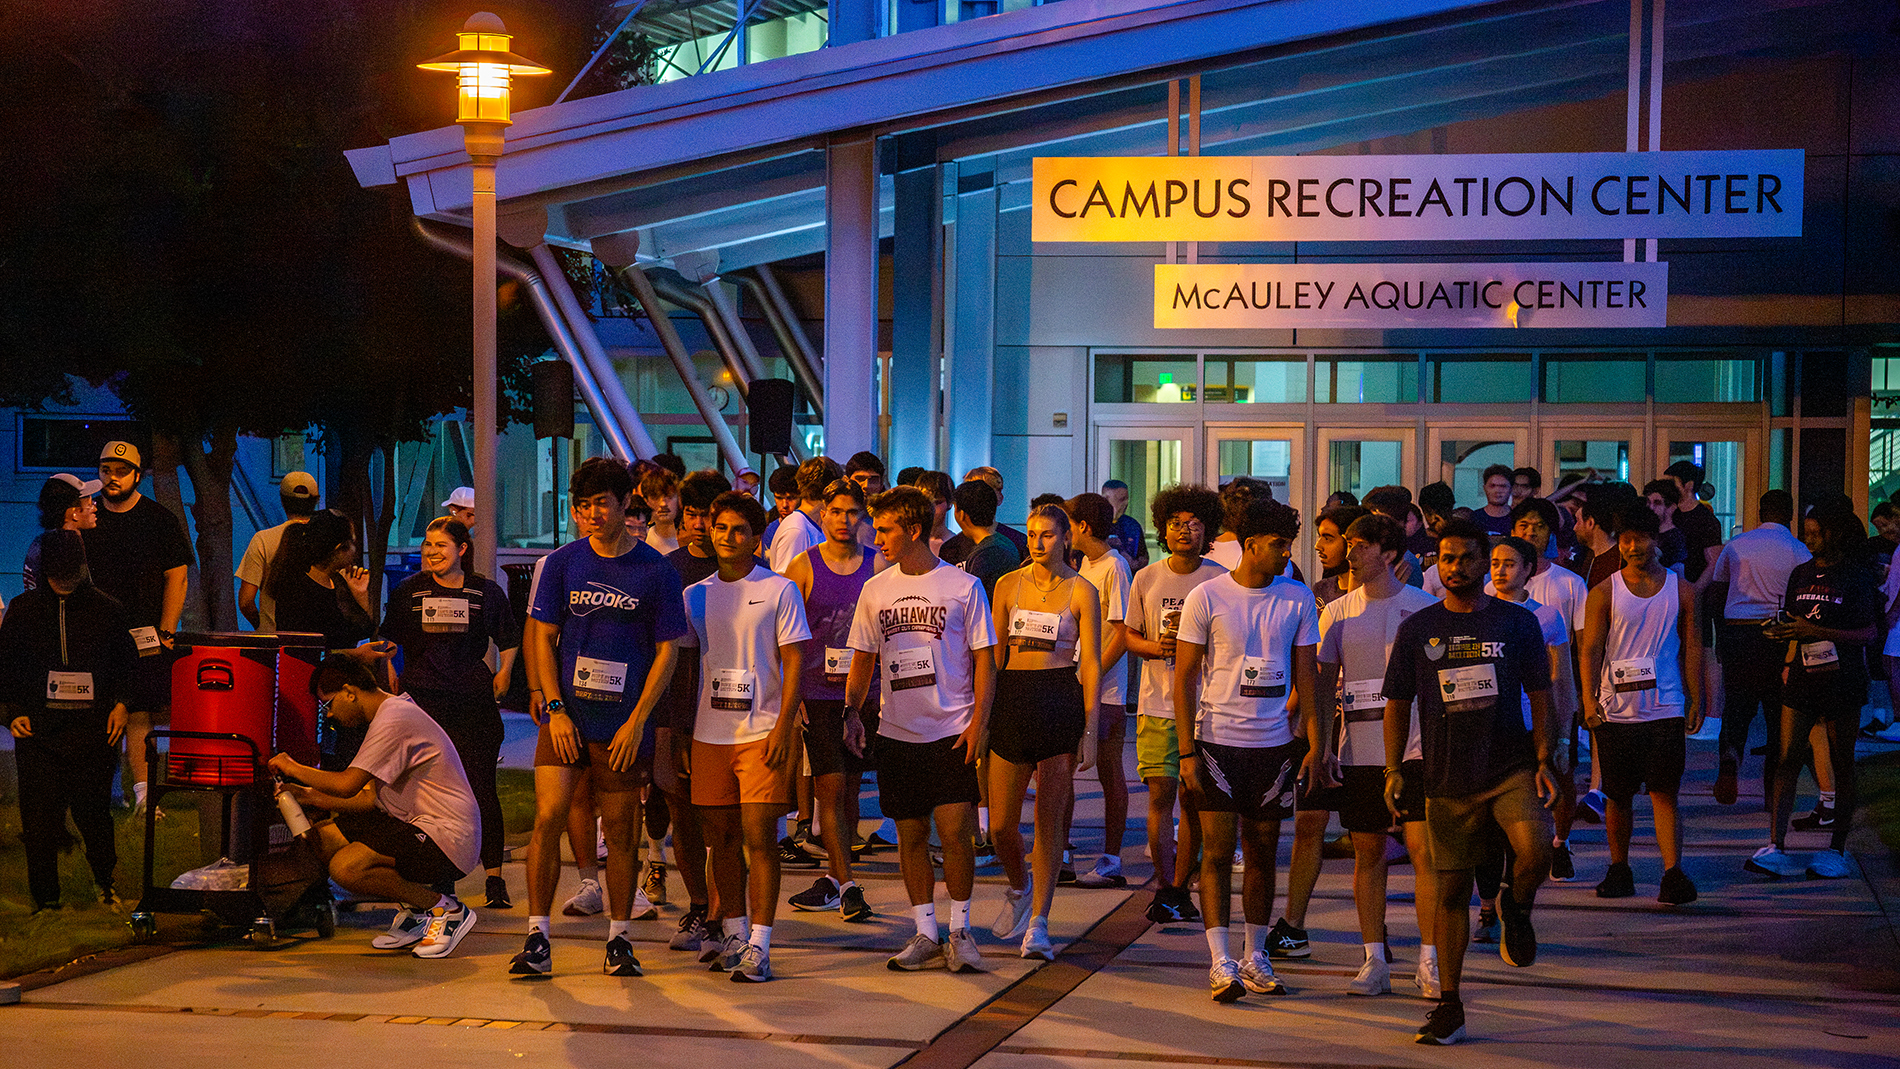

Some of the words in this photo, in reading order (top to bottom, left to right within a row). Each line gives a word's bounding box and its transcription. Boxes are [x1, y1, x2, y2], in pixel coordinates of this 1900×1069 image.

[1050, 178, 1250, 219] CAMPUS
[1268, 175, 1574, 218] RECREATION
[1591, 174, 1783, 216] CENTER
[1172, 281, 1335, 310] McAULEY
[1344, 280, 1503, 311] AQUATIC
[1513, 280, 1647, 310] CENTER
[569, 590, 639, 610] BROOKS
[453, 610, 466, 618] 5K
[879, 606, 946, 635] SEAHAWKS
[1042, 624, 1055, 634] 5K
[145, 635, 156, 643] 5K
[1481, 641, 1506, 658] 5K
[917, 660, 930, 669] 5K
[1640, 667, 1652, 676] 5K
[609, 675, 622, 685] 5K
[1478, 679, 1493, 690] 5K
[77, 685, 90, 694] 5K
[737, 683, 750, 692] 5K
